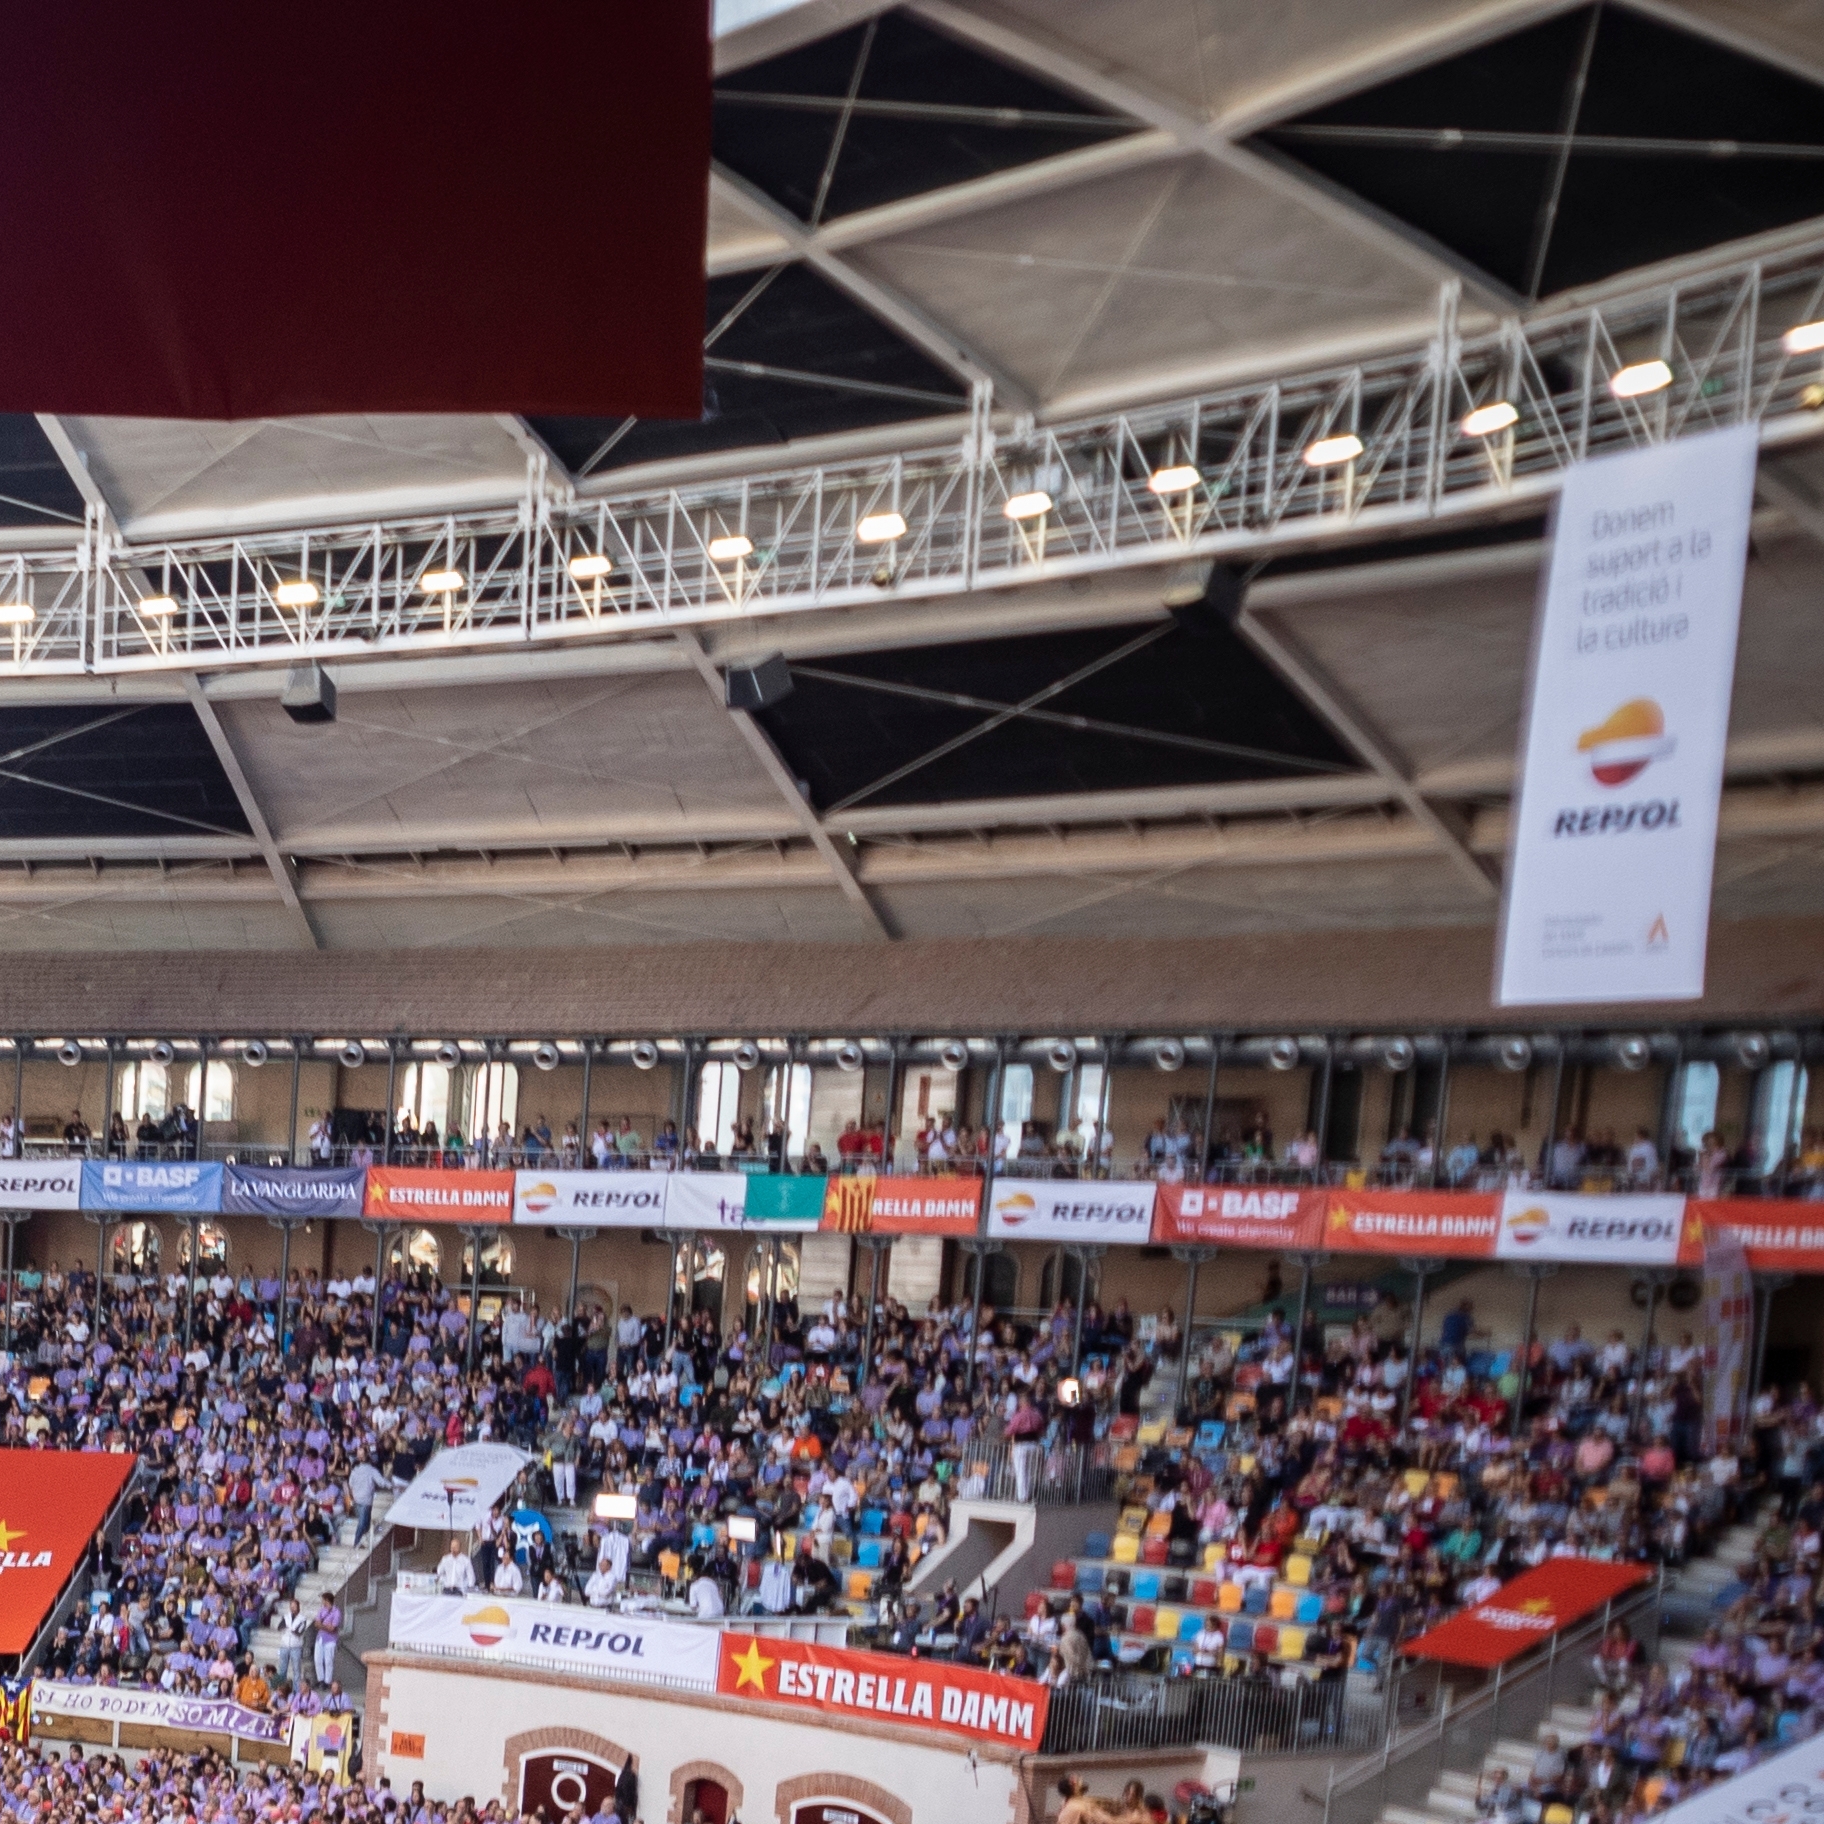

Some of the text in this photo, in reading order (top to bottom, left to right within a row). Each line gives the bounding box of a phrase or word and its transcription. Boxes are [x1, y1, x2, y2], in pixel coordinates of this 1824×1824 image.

[1552, 799, 1682, 838] REPSOL
[136, 1167, 200, 1188] BASF
[231, 1180, 356, 1199] LA VANGUARDIA
[390, 1187, 509, 1207] ESTRELLA DAMM
[572, 1190, 662, 1208] REPSOL
[924, 1199, 975, 1217] DAMM
[1053, 1204, 1147, 1225] REPSOL
[1221, 1191, 1299, 1220] BASF
[1355, 1213, 1496, 1237] ESTRELLA DAMM
[1568, 1217, 1675, 1240] REPSOL
[530, 1622, 645, 1658] REPSOL
[778, 1658, 1033, 1738] ESTRELLA DAMM
[34, 1688, 275, 1737] SI HO PODEM SOMIAR
